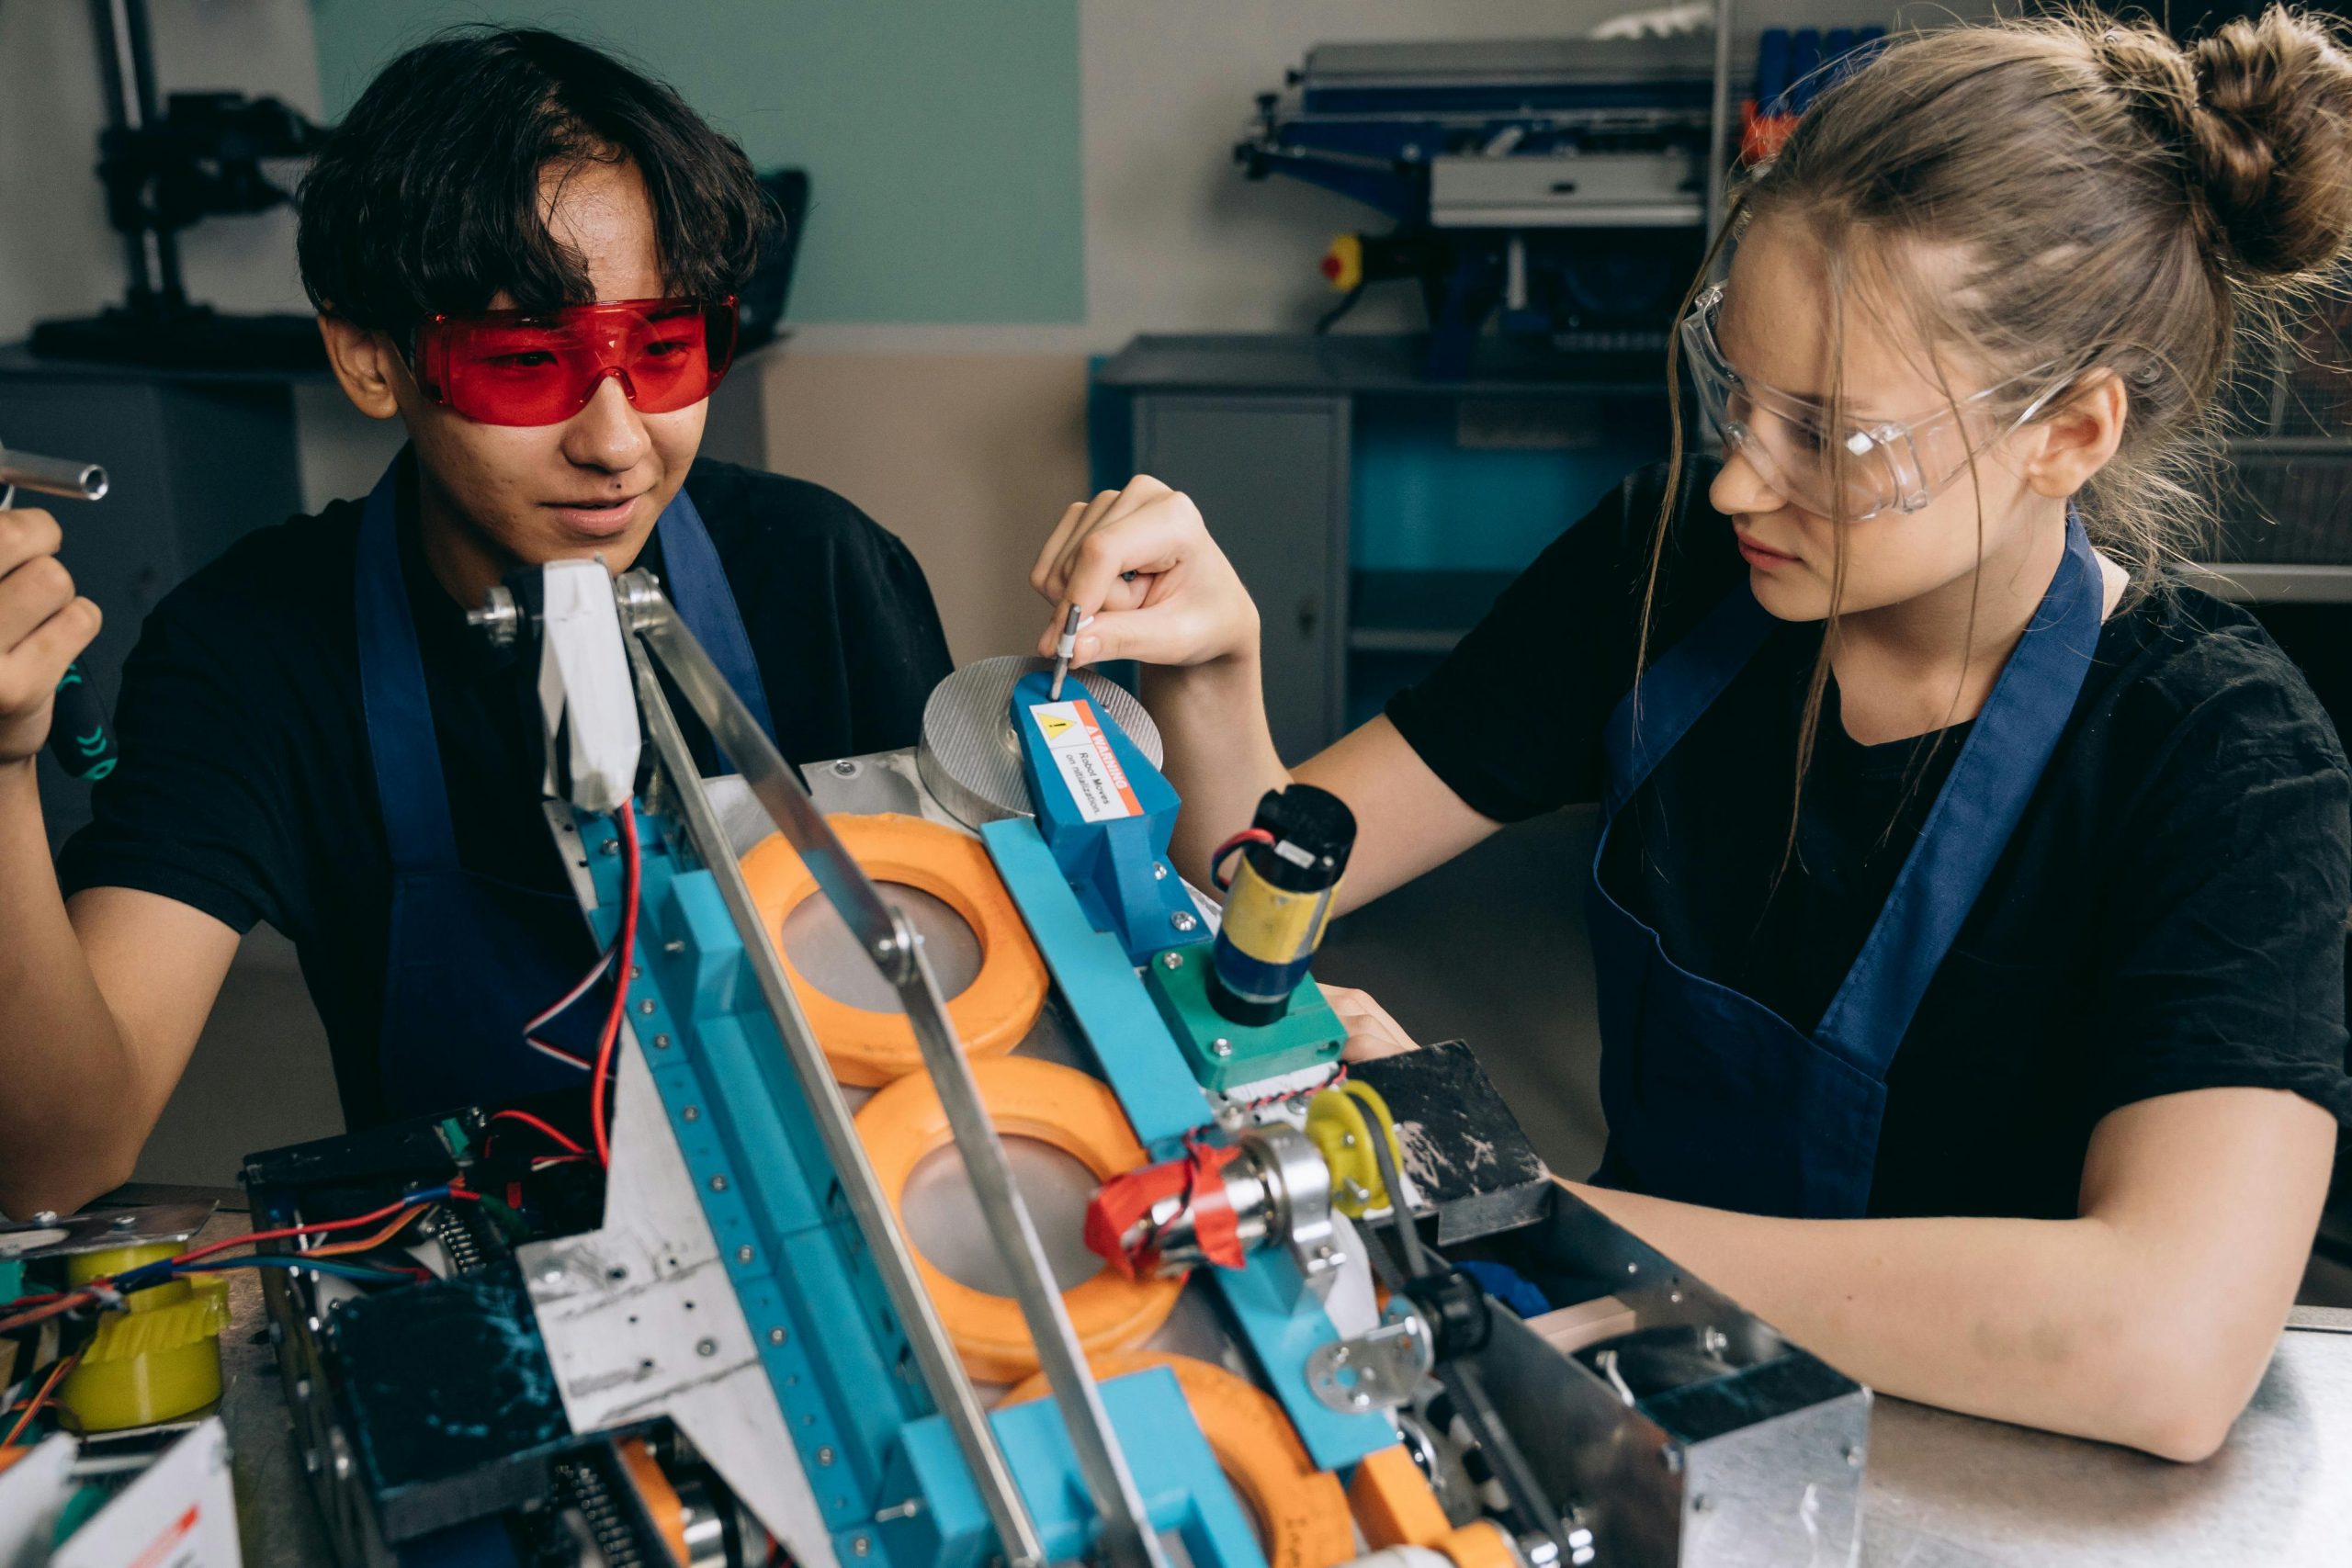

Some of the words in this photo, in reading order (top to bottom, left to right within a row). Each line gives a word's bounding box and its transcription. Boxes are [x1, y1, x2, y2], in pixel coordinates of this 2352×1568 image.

[1066, 754, 1076, 765] on
[1080, 752, 1097, 777] Robot
[1092, 778, 1110, 805] Moves
[1091, 734, 1127, 790] WARNING
